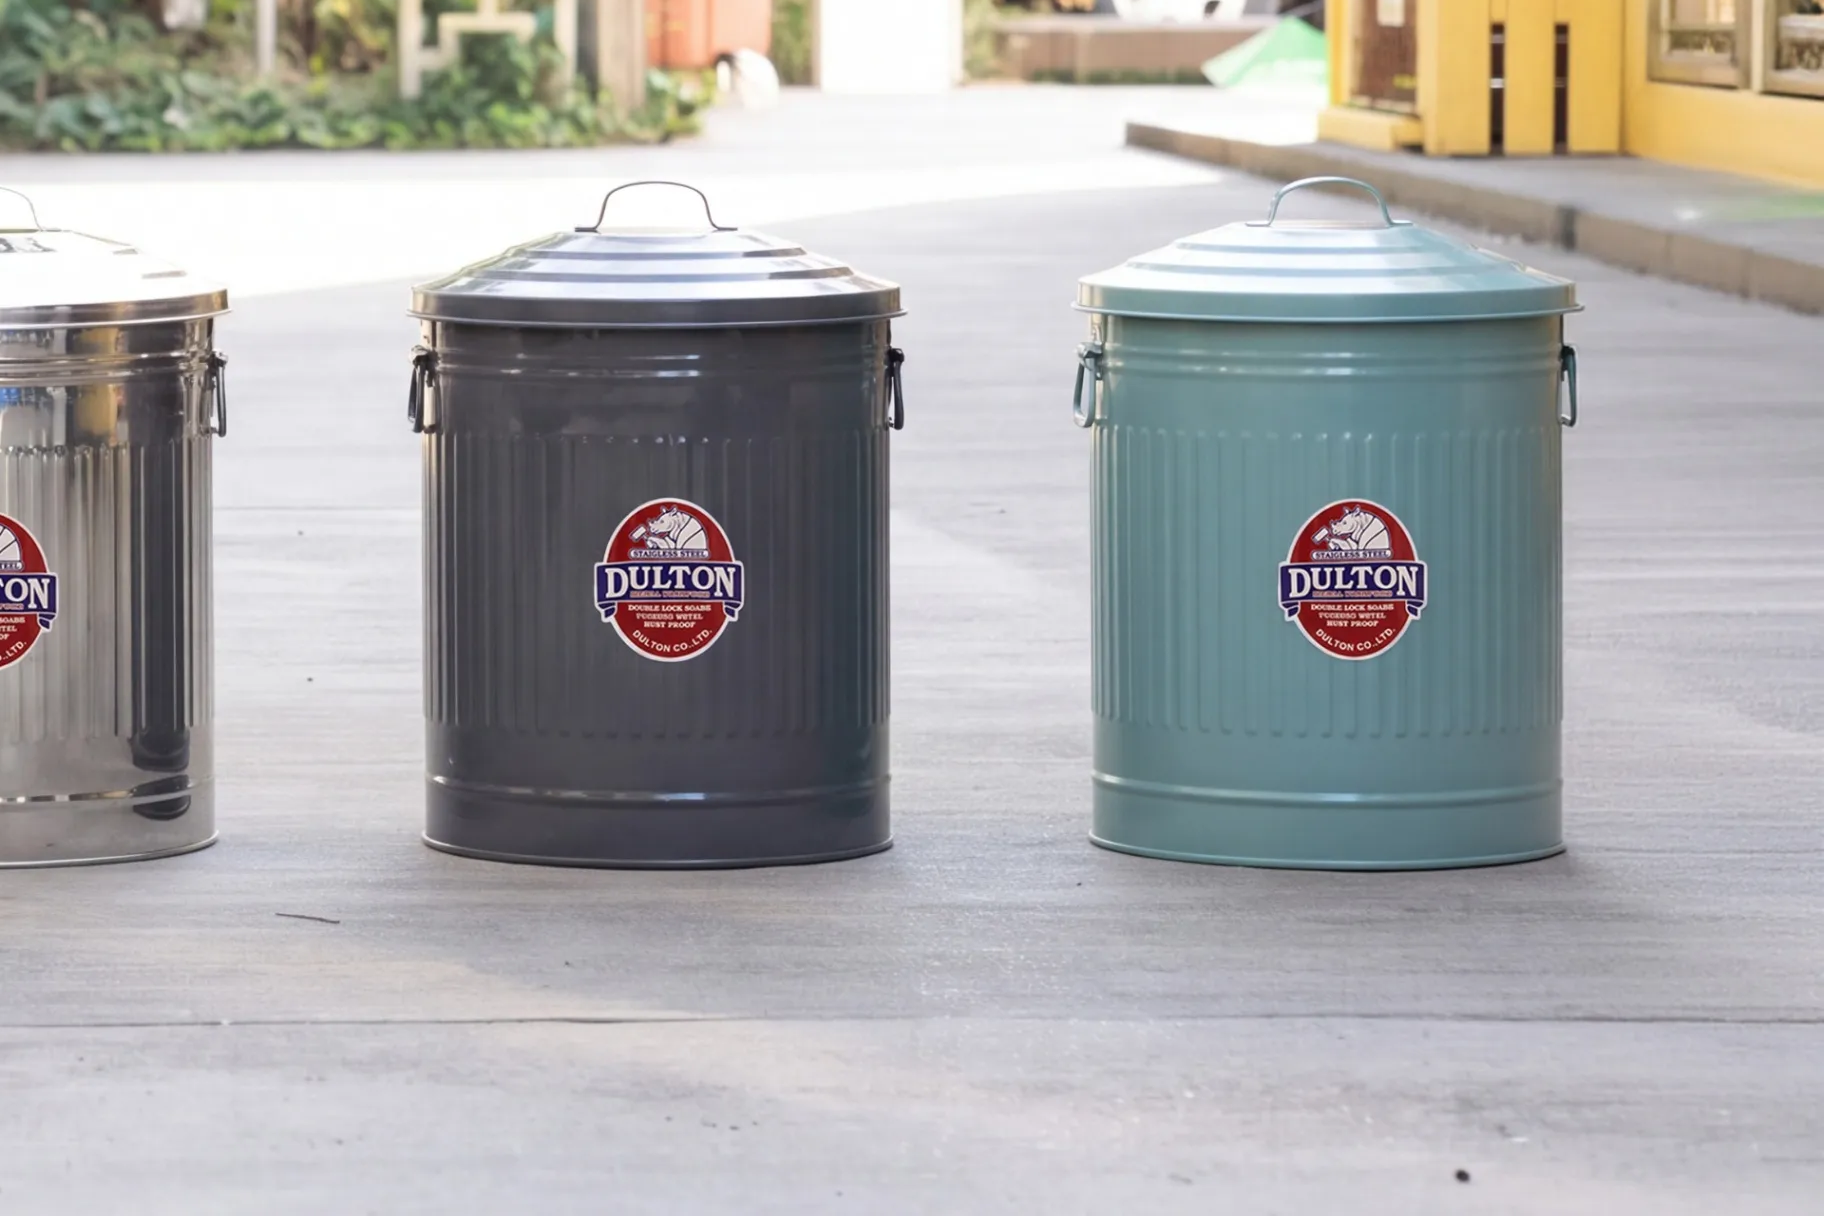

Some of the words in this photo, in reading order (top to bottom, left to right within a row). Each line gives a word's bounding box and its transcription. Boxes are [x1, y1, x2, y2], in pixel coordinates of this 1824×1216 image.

[605, 566, 736, 599] DULTON
[1288, 565, 1419, 598] DULTON
[632, 629, 671, 653] DULTON
[1315, 628, 1354, 651] DULTON
